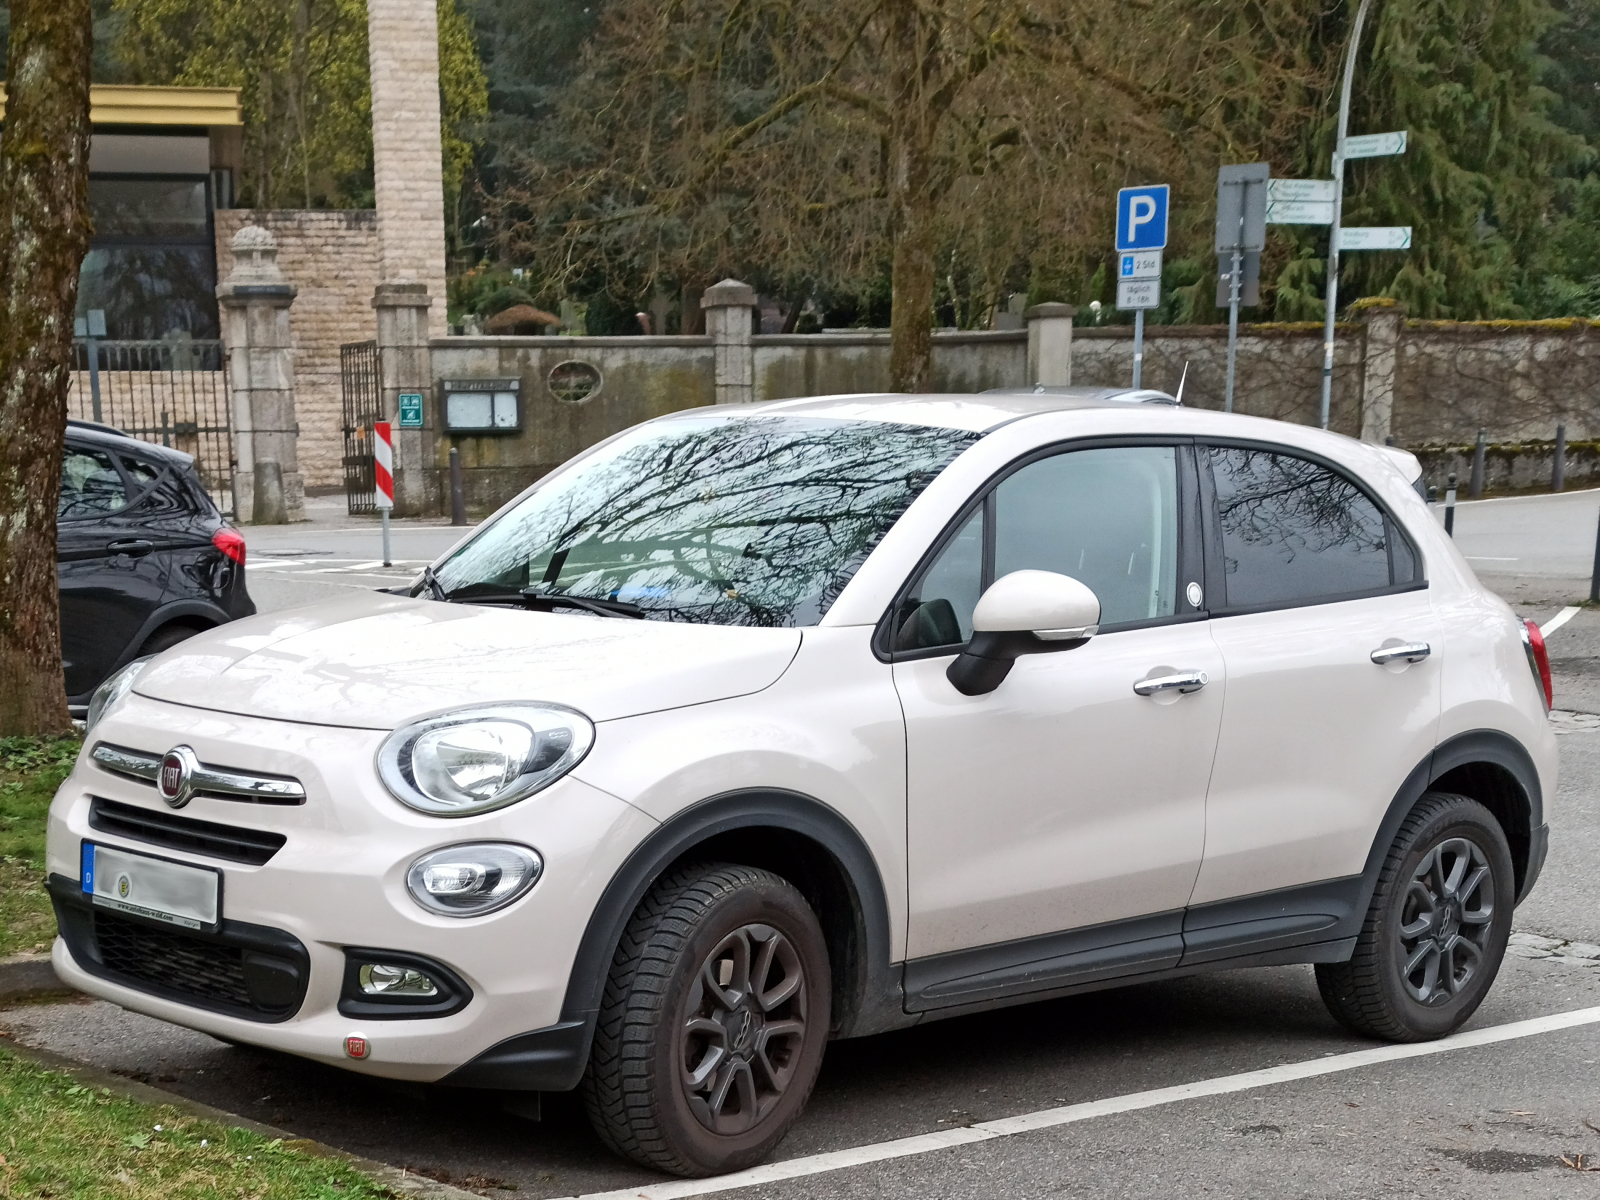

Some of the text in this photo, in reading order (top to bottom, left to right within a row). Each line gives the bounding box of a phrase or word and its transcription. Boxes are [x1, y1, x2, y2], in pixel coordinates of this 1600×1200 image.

[1128, 195, 1156, 243] P
[1136, 260, 1142, 270] 2
[163, 766, 180, 789] FIAT
[349, 1040, 364, 1053] FIAT
